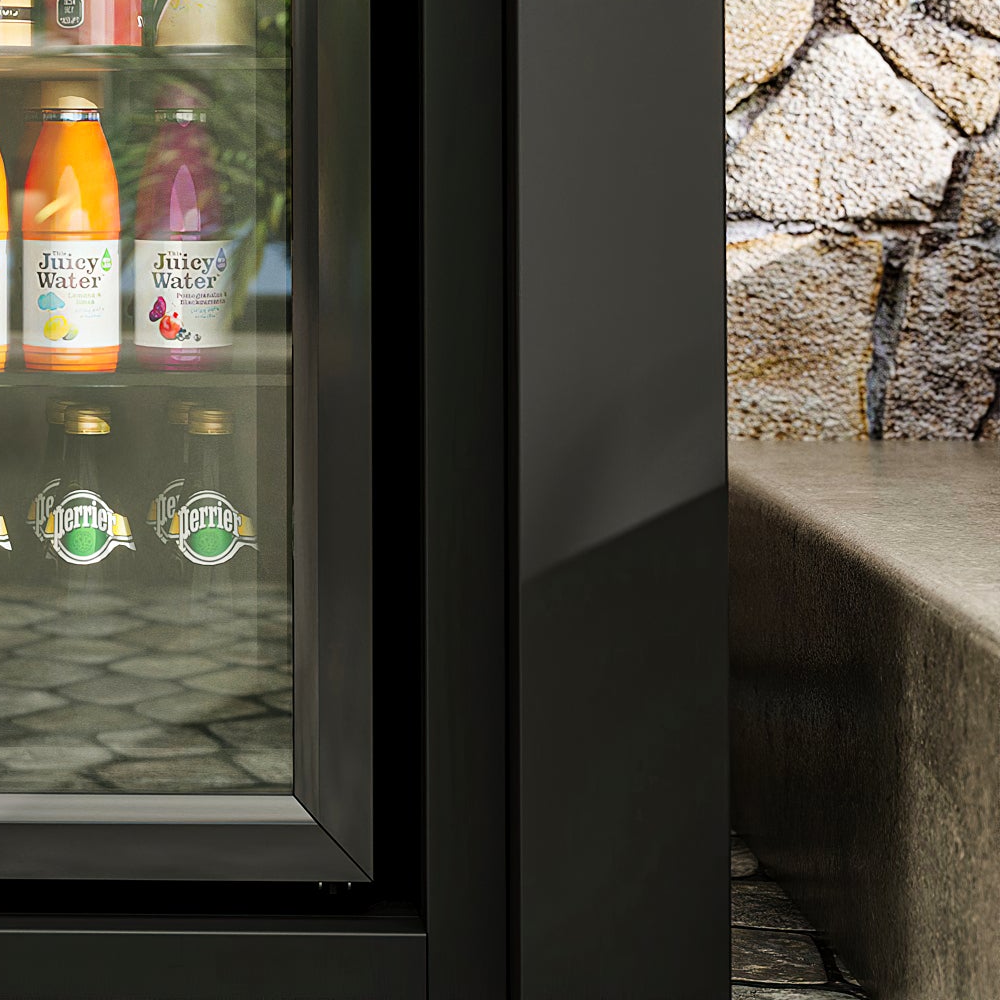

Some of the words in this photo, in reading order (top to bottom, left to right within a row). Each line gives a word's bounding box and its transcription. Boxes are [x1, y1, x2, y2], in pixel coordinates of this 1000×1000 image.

[38, 252, 99, 275] Juicy
[154, 252, 214, 275] Juicy
[36, 271, 101, 289] Water
[152, 271, 217, 289] Water
